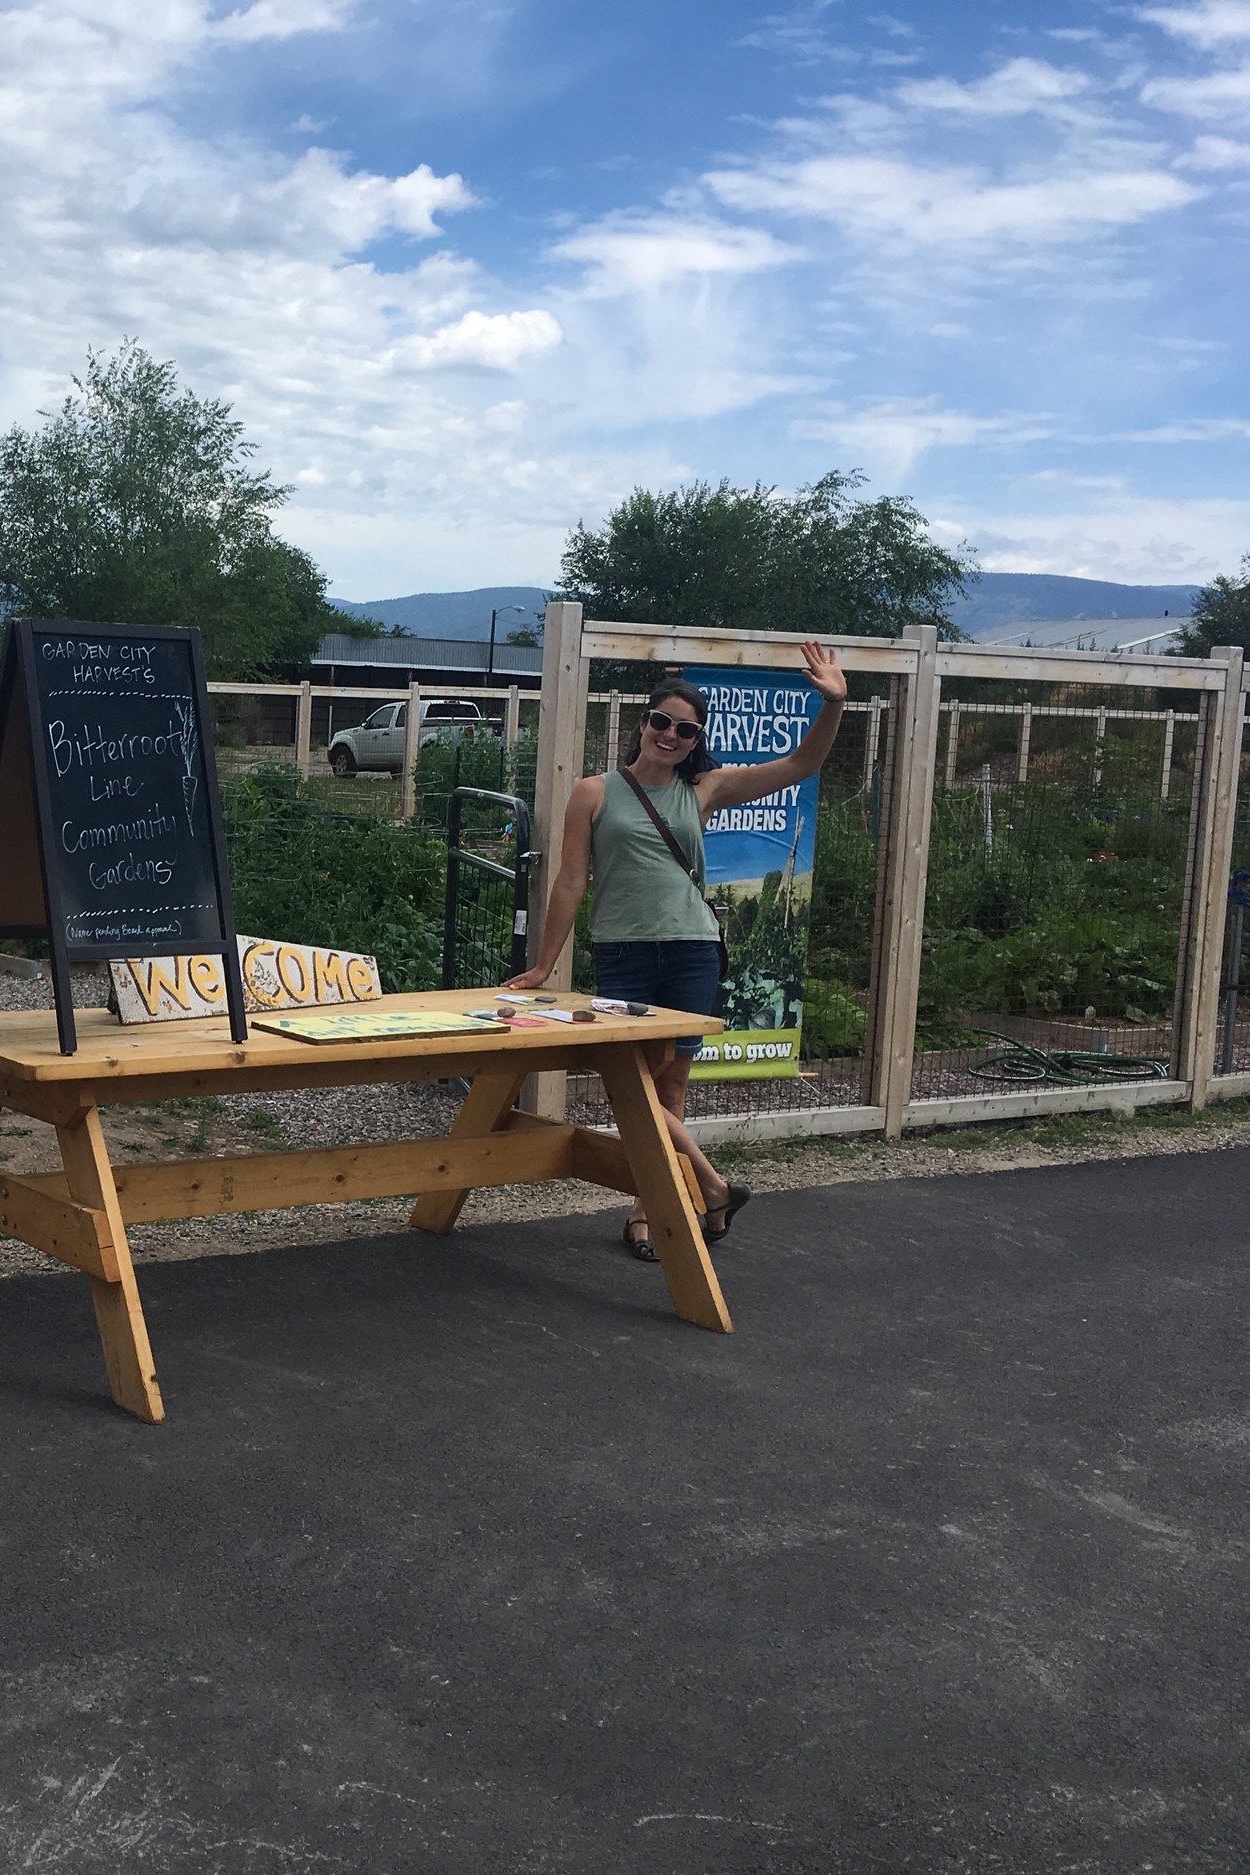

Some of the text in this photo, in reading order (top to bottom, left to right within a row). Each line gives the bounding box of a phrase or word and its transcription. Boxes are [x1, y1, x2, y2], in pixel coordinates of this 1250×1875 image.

[42, 640, 156, 664] GARDEN CITY
[73, 664, 155, 684] HARVEST'S
[773, 690, 811, 714] CITY
[48, 720, 183, 778] Bitterroot
[90, 775, 144, 802] Line
[705, 809, 787, 832] GARDENS
[61, 803, 178, 866] Community
[88, 852, 173, 890] Gardens
[95, 925, 121, 940] pending
[724, 1043, 743, 1060] to
[746, 1042, 792, 1064] grow
